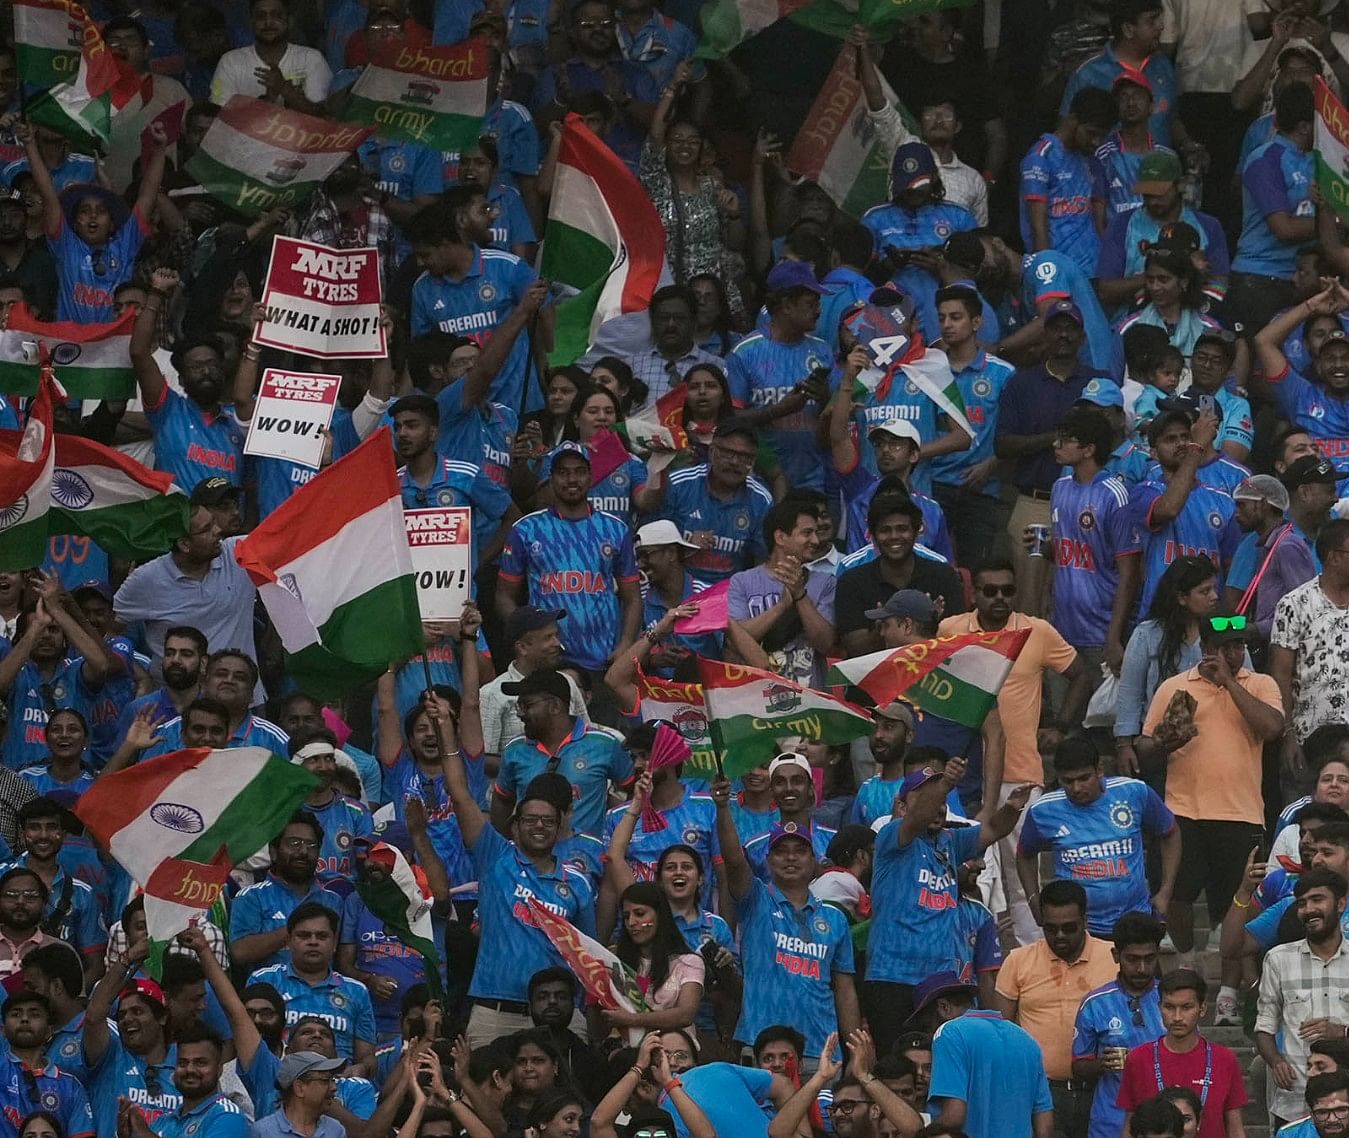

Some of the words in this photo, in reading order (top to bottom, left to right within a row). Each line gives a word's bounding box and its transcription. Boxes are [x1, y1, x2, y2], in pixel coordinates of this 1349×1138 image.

[396, 46, 475, 78] bharat
[374, 104, 435, 141] army
[291, 246, 366, 280] MRF
[302, 279, 358, 302] TYRES
[265, 302, 318, 331] WHAT
[320, 317, 331, 335] A
[868, 335, 908, 365] 4
[266, 371, 336, 389] MRF
[275, 387, 324, 401] TYRES
[865, 406, 920, 421] DREAM11
[187, 444, 236, 471] INDIA
[404, 510, 464, 530] MRF
[409, 528, 457, 545] TYRES
[539, 570, 607, 594] INDIA
[1061, 841, 1132, 862] DREAM11
[1070, 860, 1127, 878] INDIA
